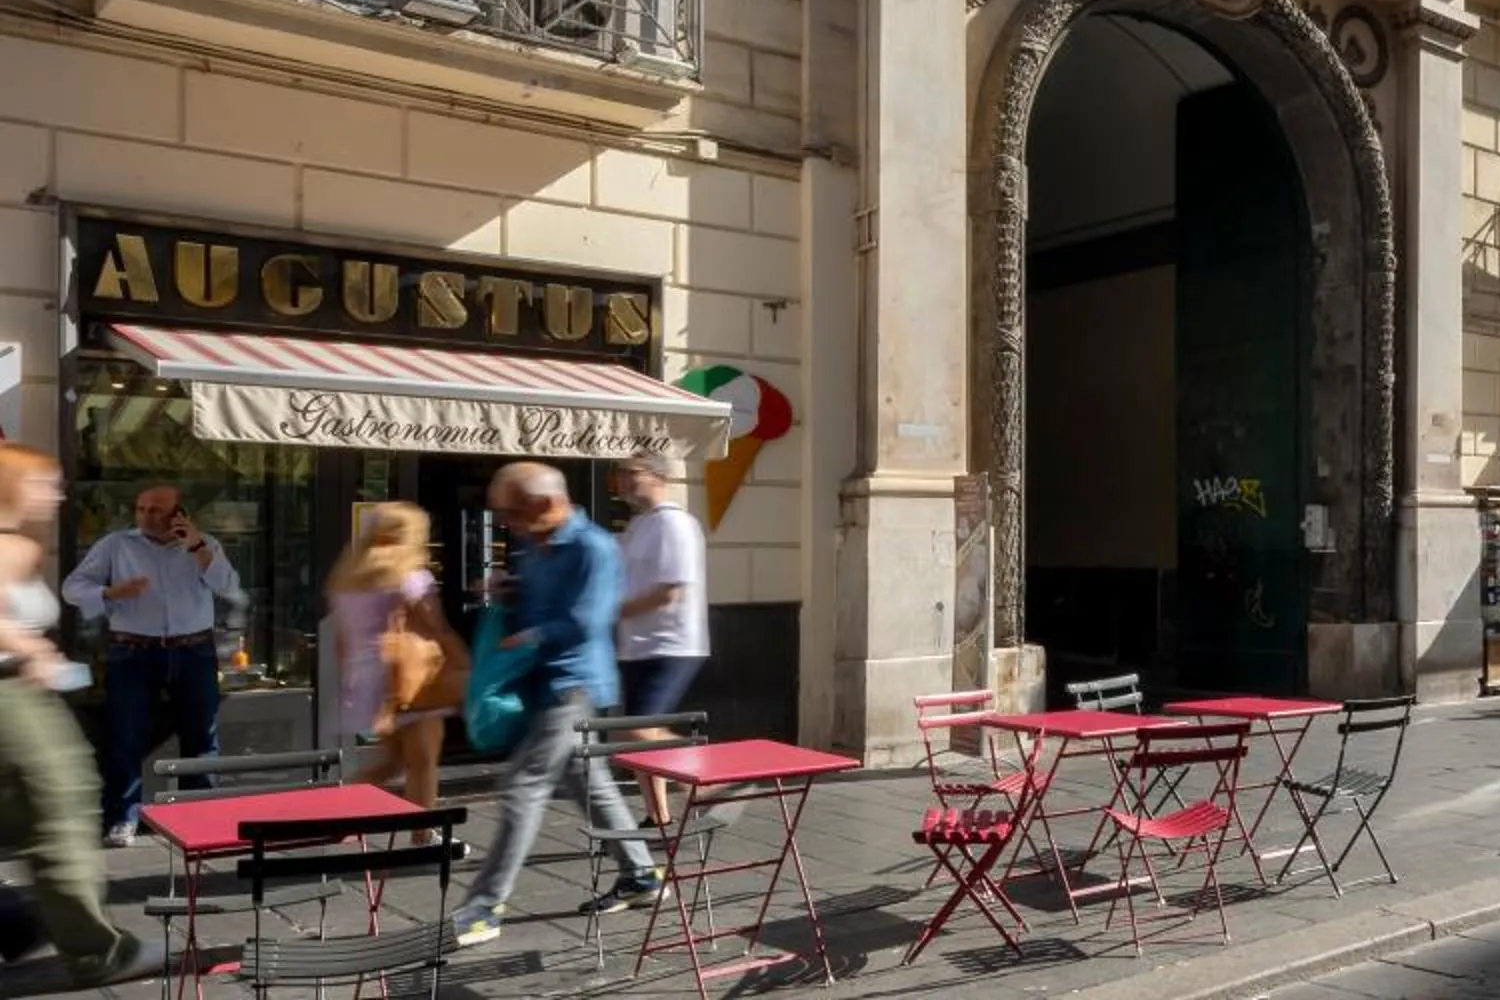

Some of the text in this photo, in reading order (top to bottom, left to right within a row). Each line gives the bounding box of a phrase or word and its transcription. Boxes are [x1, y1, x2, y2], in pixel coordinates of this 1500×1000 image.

[93, 232, 650, 346] AUGUSTUS
[280, 391, 673, 451] Gastronomia Pasticceria
